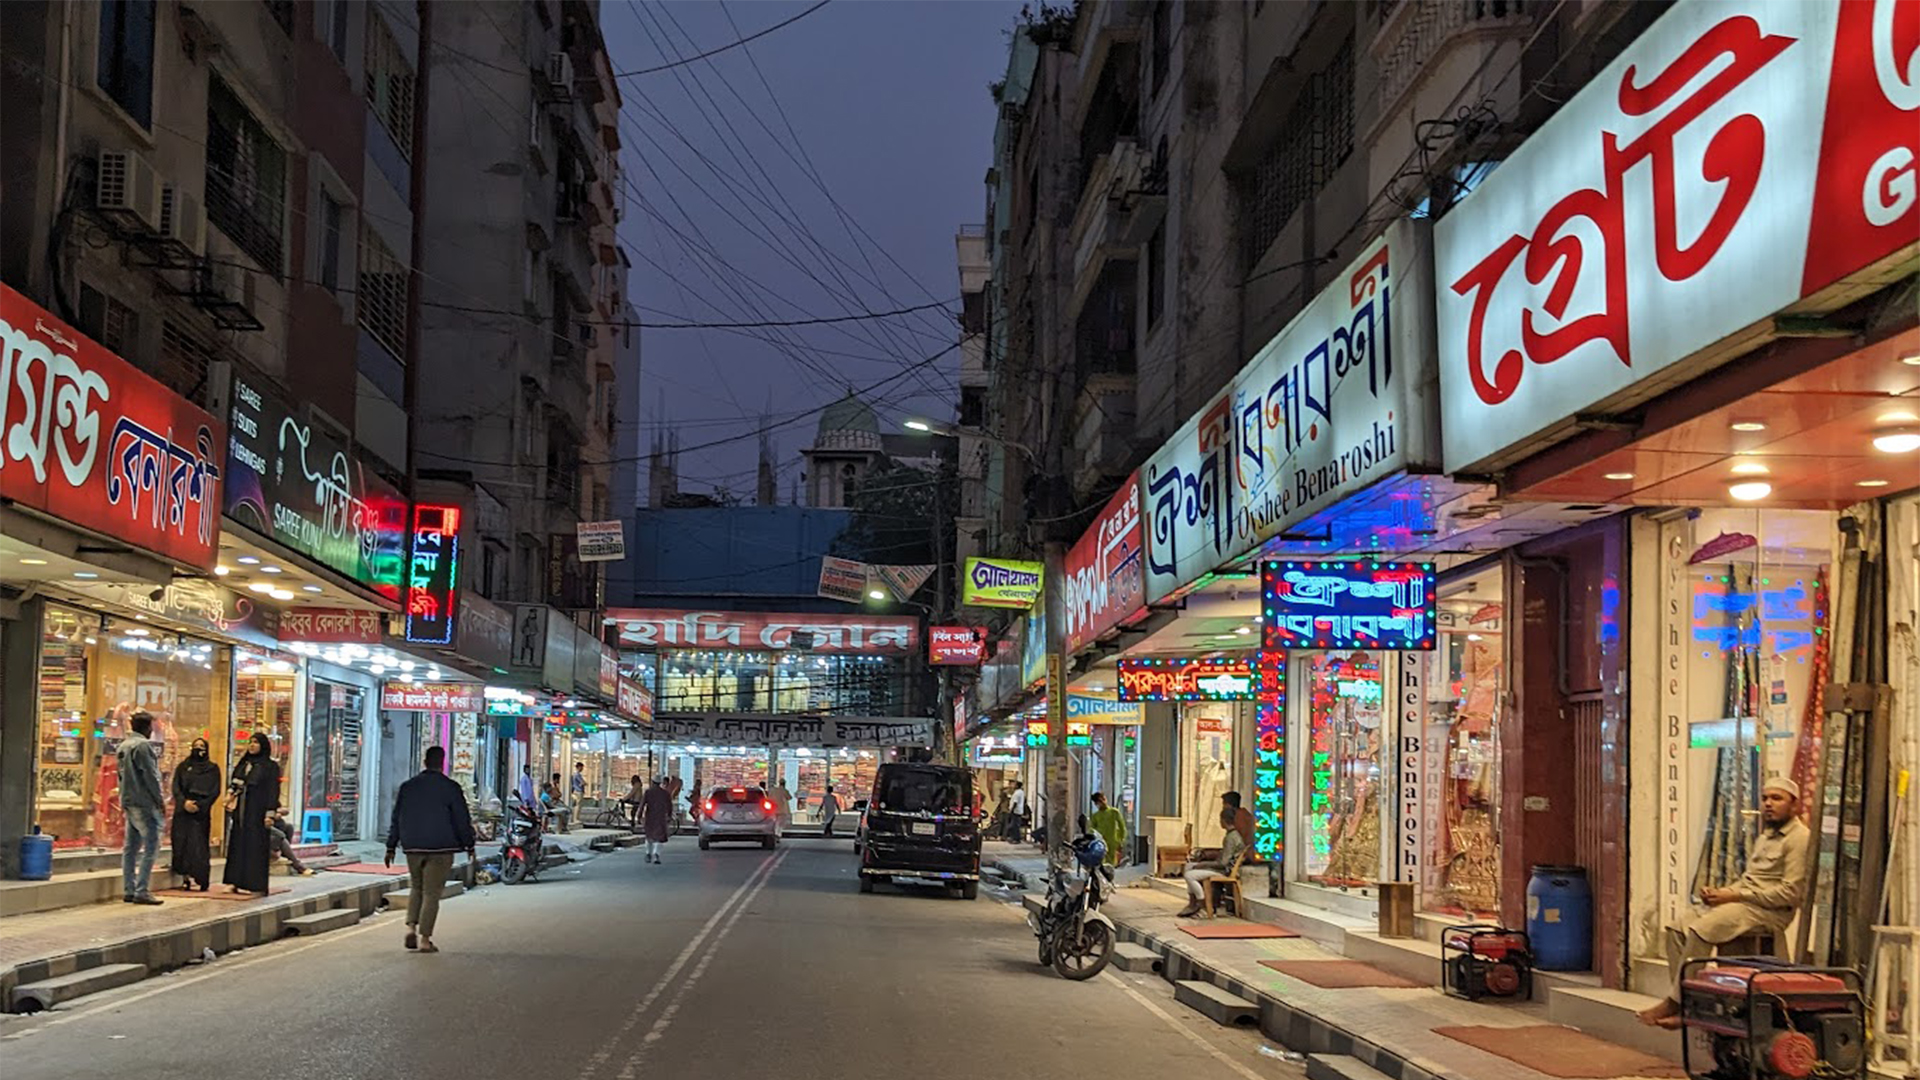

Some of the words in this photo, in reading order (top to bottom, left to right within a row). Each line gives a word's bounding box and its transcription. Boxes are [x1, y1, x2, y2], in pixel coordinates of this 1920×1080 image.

[237, 413, 258, 439] SUITS
[239, 383, 262, 412] SAREE
[1295, 410, 1396, 508] Benaroshi
[274, 502, 300, 539] SAREE
[301, 518, 324, 551] KUNJ
[1403, 736, 1420, 883] Benaroshi
[1667, 715, 1681, 921] Benaroshi
